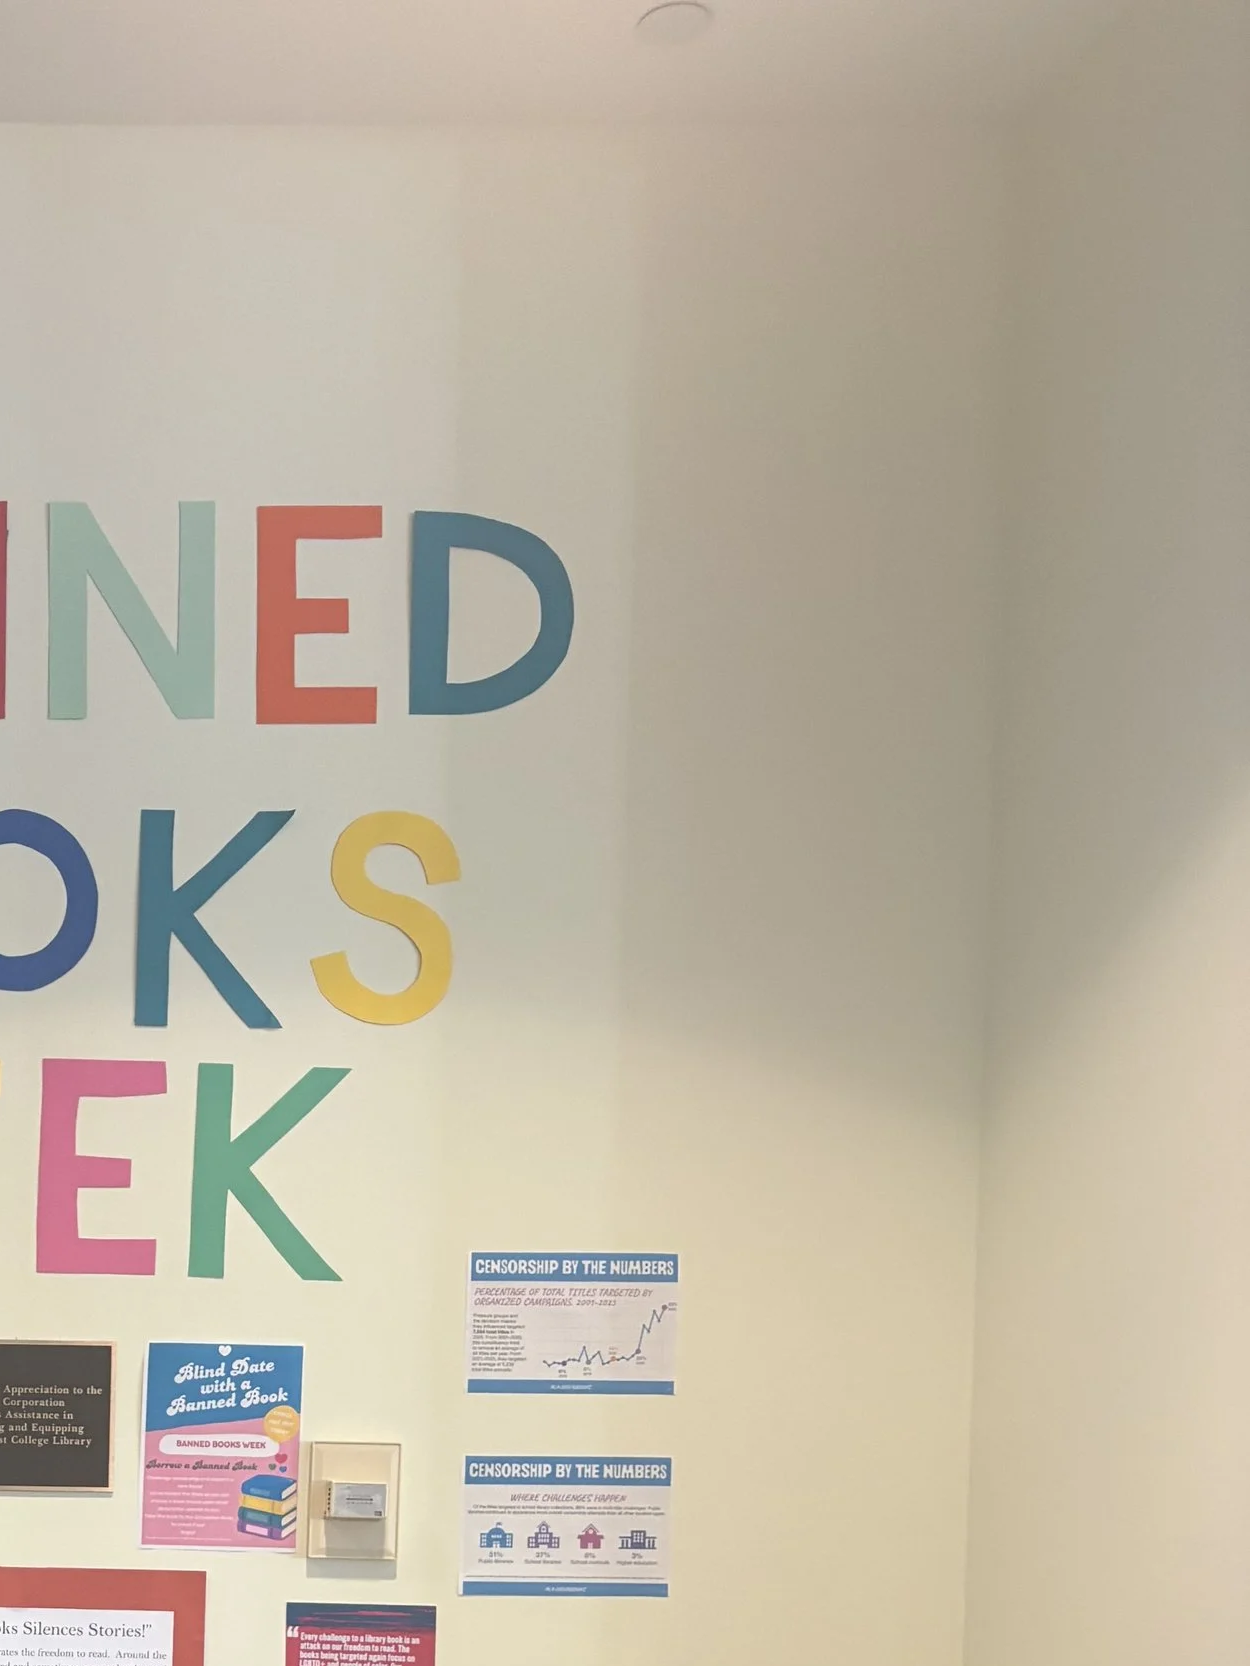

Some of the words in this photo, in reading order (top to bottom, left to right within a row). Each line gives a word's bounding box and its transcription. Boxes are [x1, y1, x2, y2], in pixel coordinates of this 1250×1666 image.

[476, 1259, 558, 1275] CENSORSHIP
[562, 1260, 579, 1274] BY
[582, 1261, 606, 1274] THE
[610, 1260, 674, 1276] NUMBERS
[174, 1362, 226, 1384] Blind
[230, 1357, 275, 1380] Date
[3, 1385, 70, 1396] Appreciation
[73, 1387, 83, 1395] to
[86, 1386, 102, 1396] the
[201, 1379, 236, 1395] with
[240, 1381, 251, 1390] a
[3, 1397, 65, 1409] Corporation
[166, 1396, 236, 1416] Banned
[241, 1388, 288, 1408] Book
[6, 1410, 59, 1420] Assistance
[63, 1411, 73, 1420] in
[8, 1423, 27, 1432] and
[31, 1423, 84, 1435] Equipping
[11, 1435, 48, 1447] College
[53, 1436, 91, 1448] Library
[176, 1440, 210, 1448] BANNED
[212, 1440, 241, 1448] BOOKS
[242, 1441, 266, 1449] WEEK
[469, 1462, 552, 1479] CENSORSHIP
[556, 1464, 571, 1477] BY
[576, 1464, 600, 1478] THE
[603, 1463, 667, 1480] NUMBERS
[23, 1622, 83, 1636] Silences
[88, 1623, 152, 1638] Stories!”
